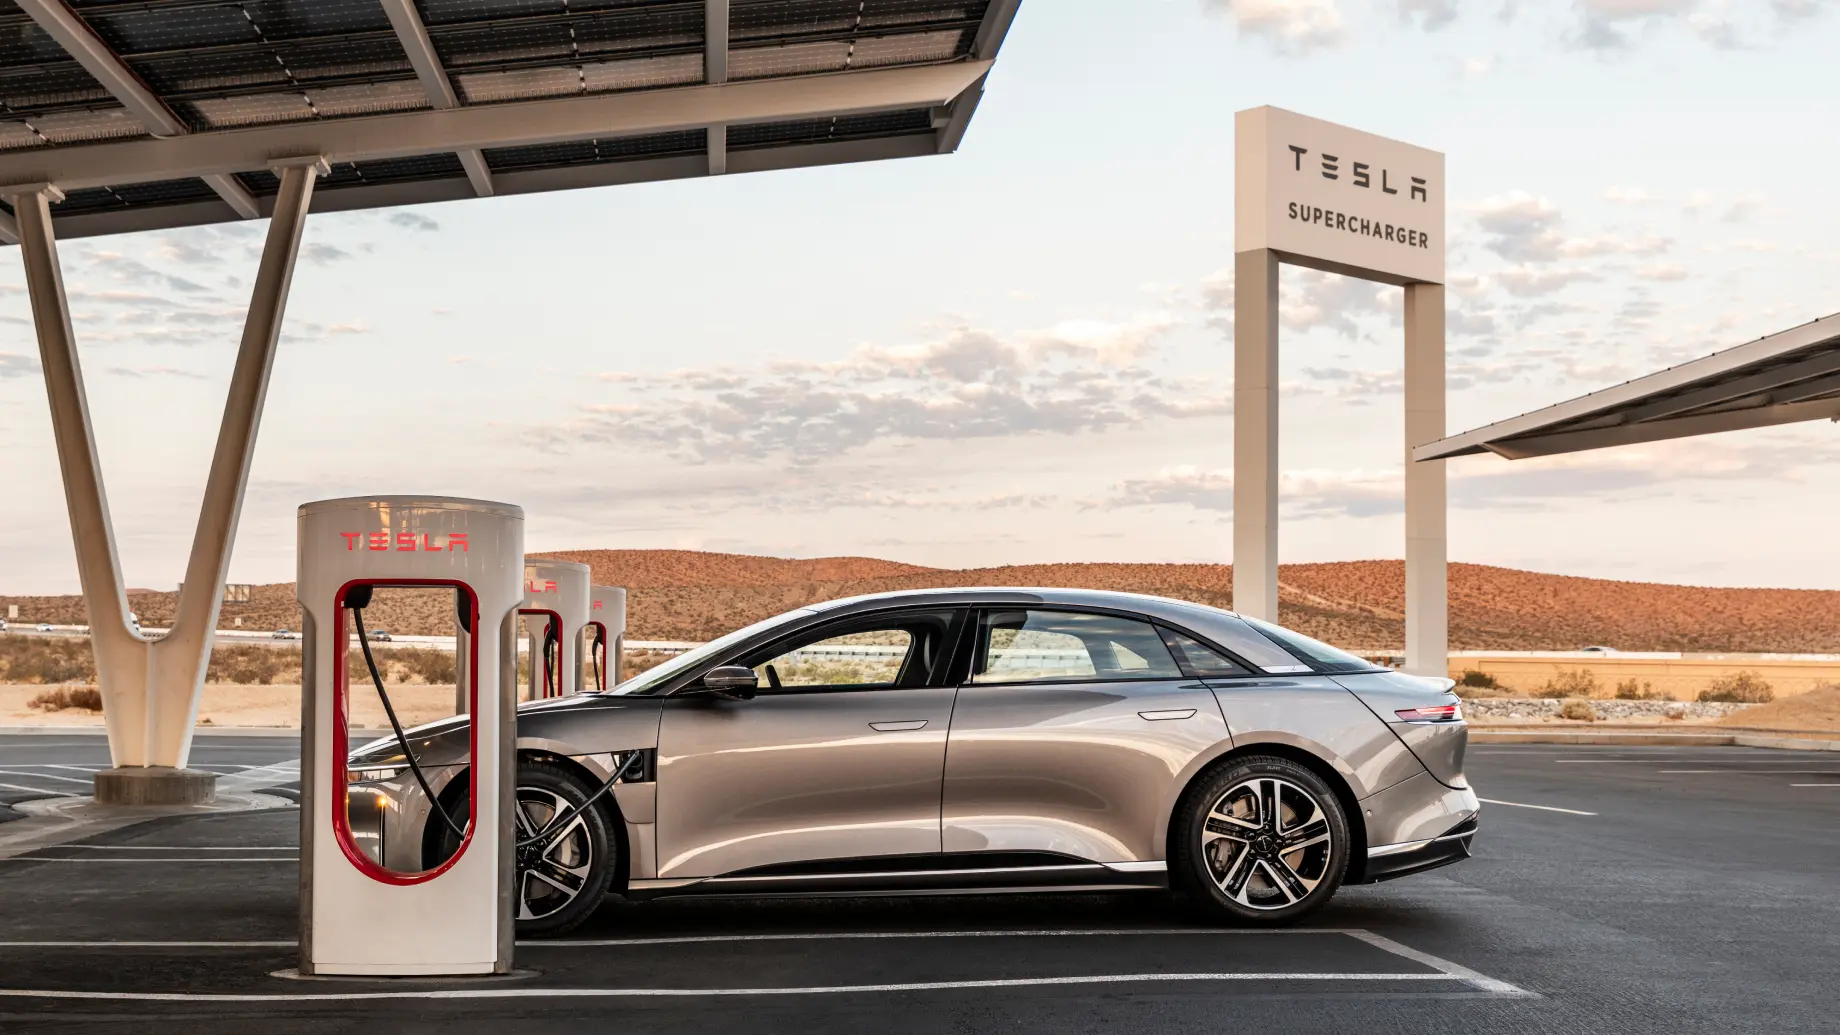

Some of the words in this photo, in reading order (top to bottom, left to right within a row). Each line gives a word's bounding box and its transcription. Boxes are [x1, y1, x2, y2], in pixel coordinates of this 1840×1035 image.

[1288, 144, 1427, 203] TESLA
[1288, 201, 1429, 249] SUPERCHARGER
[340, 532, 469, 552] TESLA
